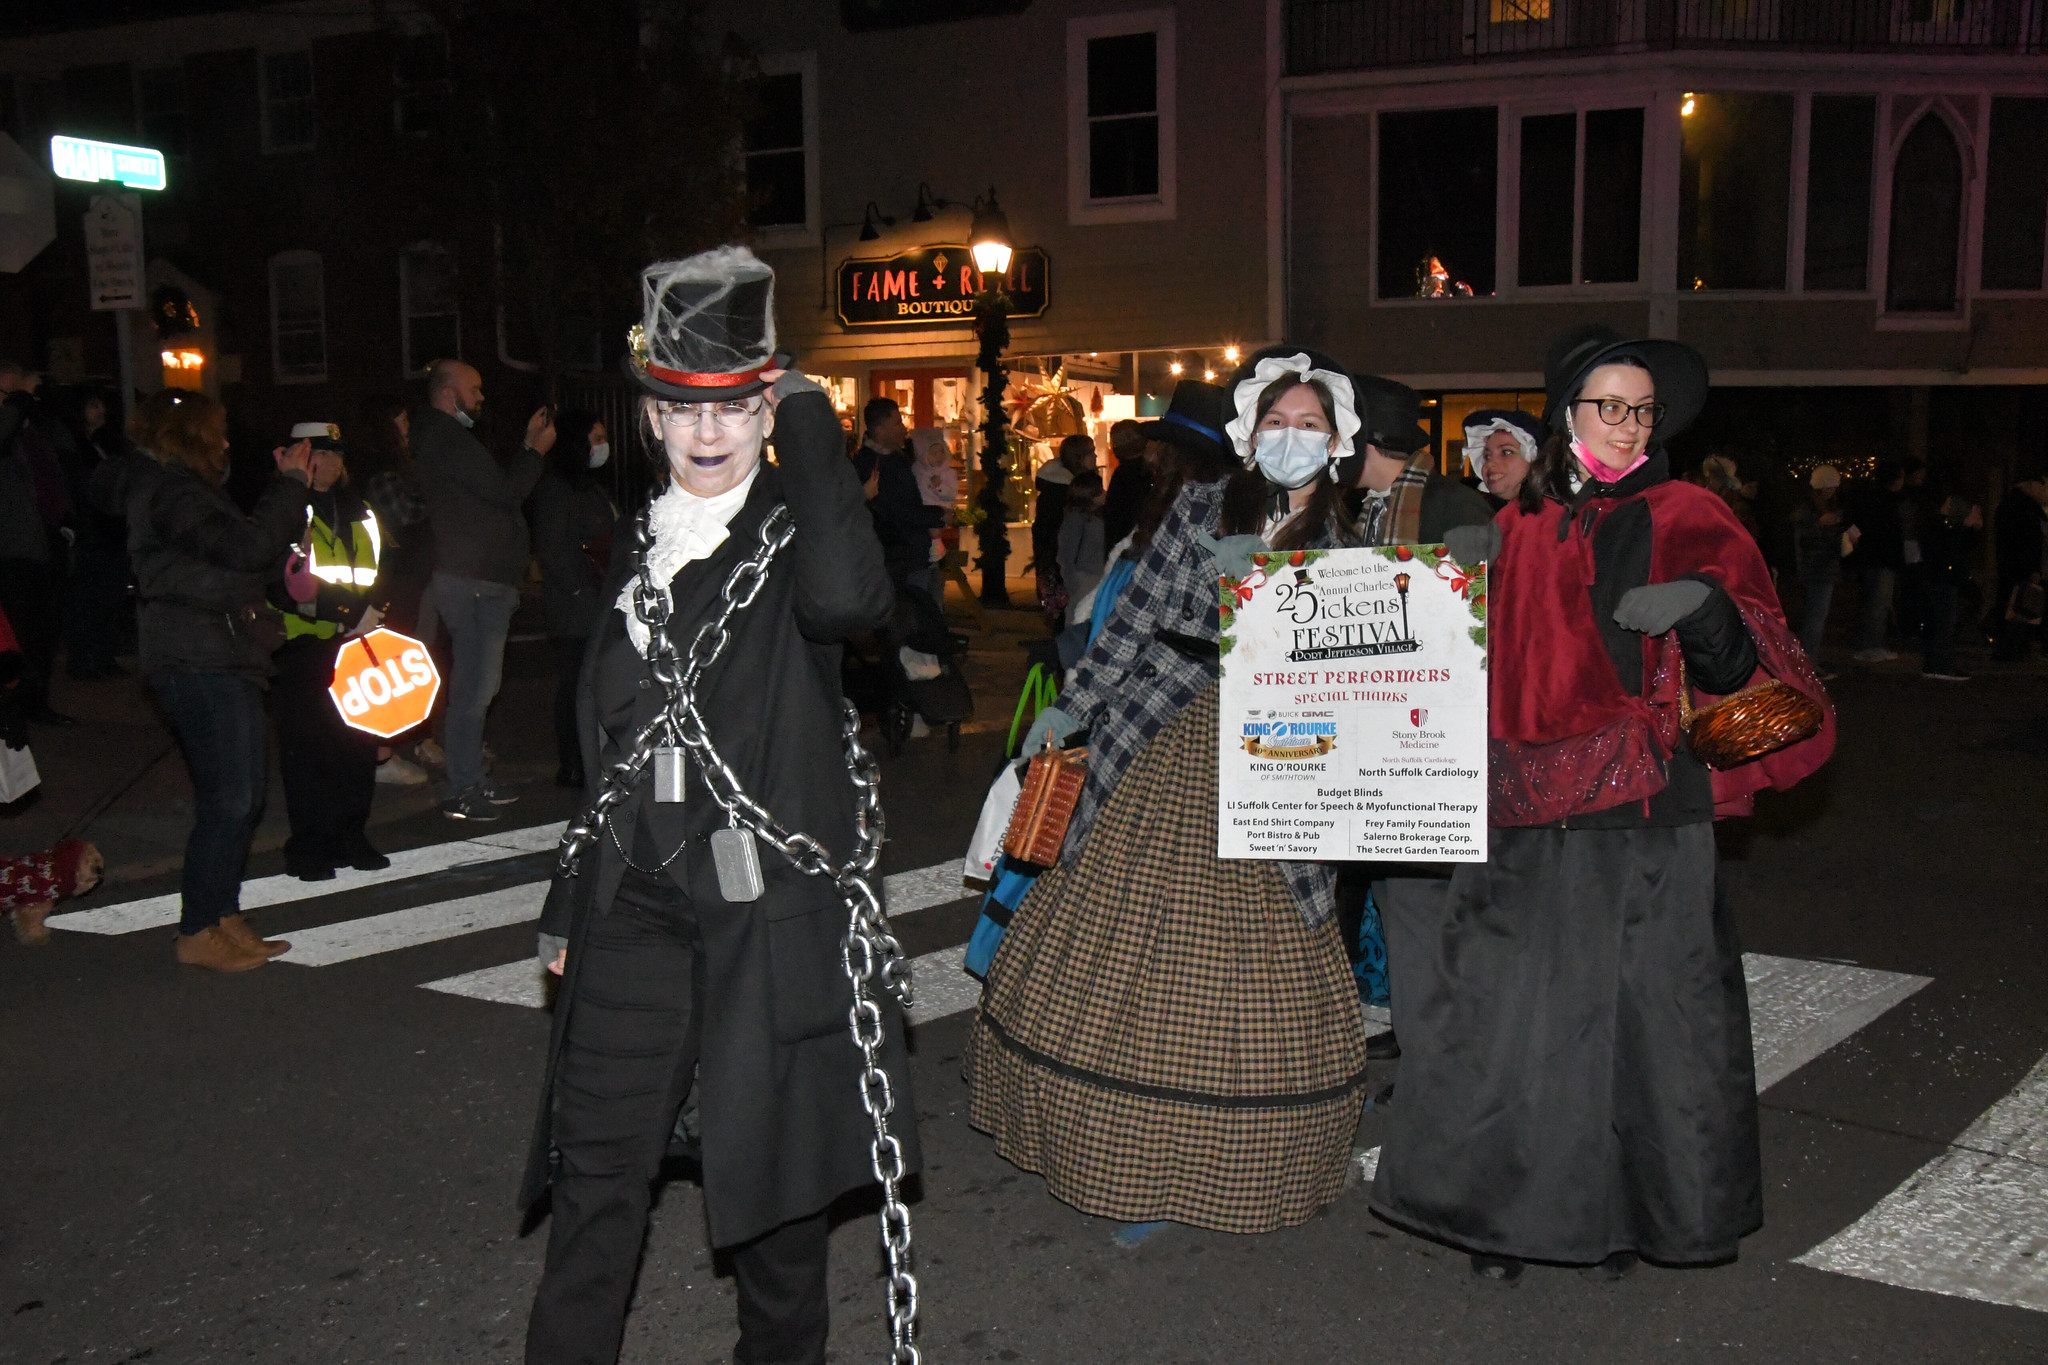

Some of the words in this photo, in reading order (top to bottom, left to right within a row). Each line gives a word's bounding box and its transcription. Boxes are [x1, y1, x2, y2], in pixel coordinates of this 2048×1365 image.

[853, 270, 920, 302] FAME
[897, 300, 976, 315] BOUTIQU
[1318, 568, 1359, 579] Welcome
[1362, 565, 1371, 574] to
[1374, 563, 1389, 573] the
[1319, 584, 1352, 597] Annual
[1354, 580, 1395, 593] Charles
[1292, 620, 1415, 650] FESTIVAL
[341, 648, 432, 716] STOP
[1253, 671, 1319, 686] STREET
[1323, 668, 1451, 685] PERFORMERS
[1294, 691, 1349, 705] SPECIAL
[1353, 690, 1408, 703] THANKS
[1243, 722, 1271, 736] KING
[1392, 730, 1417, 741] Stony
[1420, 730, 1446, 739] Brook
[1399, 740, 1440, 749] Medicine
[1267, 746, 1324, 758] ANNIVERSARY
[1382, 756, 1400, 764] North
[1401, 756, 1423, 764] Suffolk
[1424, 756, 1457, 765] Cardiology
[1250, 763, 1274, 772] KING
[1359, 768, 1387, 777] North
[1389, 768, 1423, 777] Suffolk
[1425, 768, 1479, 779] Cardiology
[1317, 788, 1352, 799] Budget
[1354, 788, 1383, 797] Blinds
[1227, 801, 1236, 810] LI
[1237, 801, 1270, 810] Suffolk
[1272, 801, 1302, 810] Center
[1304, 801, 1318, 810] for
[1320, 801, 1354, 812] Speech
[1356, 802, 1364, 811] &
[1365, 802, 1436, 812] Myofunctional
[1438, 802, 1478, 813] Therapy
[1233, 818, 1251, 826] East
[1252, 818, 1269, 826] End
[1271, 818, 1292, 827] Shirt
[1294, 818, 1335, 829] Company
[1365, 819, 1384, 829] Frey
[1386, 819, 1416, 830] Family
[1418, 819, 1471, 828] Foundation
[1247, 831, 1265, 839] Port
[1267, 831, 1292, 839] Bistro
[1294, 831, 1301, 839] &
[1303, 831, 1320, 840] Pub
[1363, 832, 1397, 841] Salerno
[1399, 832, 1446, 843] Brokerage
[1448, 833, 1473, 844] Corp.
[1249, 844, 1275, 852] Sweet
[1287, 844, 1318, 854] Savory
[1356, 845, 1373, 853] The
[1374, 845, 1402, 854] Secret
[1404, 846, 1438, 855] Garden
[1439, 846, 1480, 855] Tearoom
